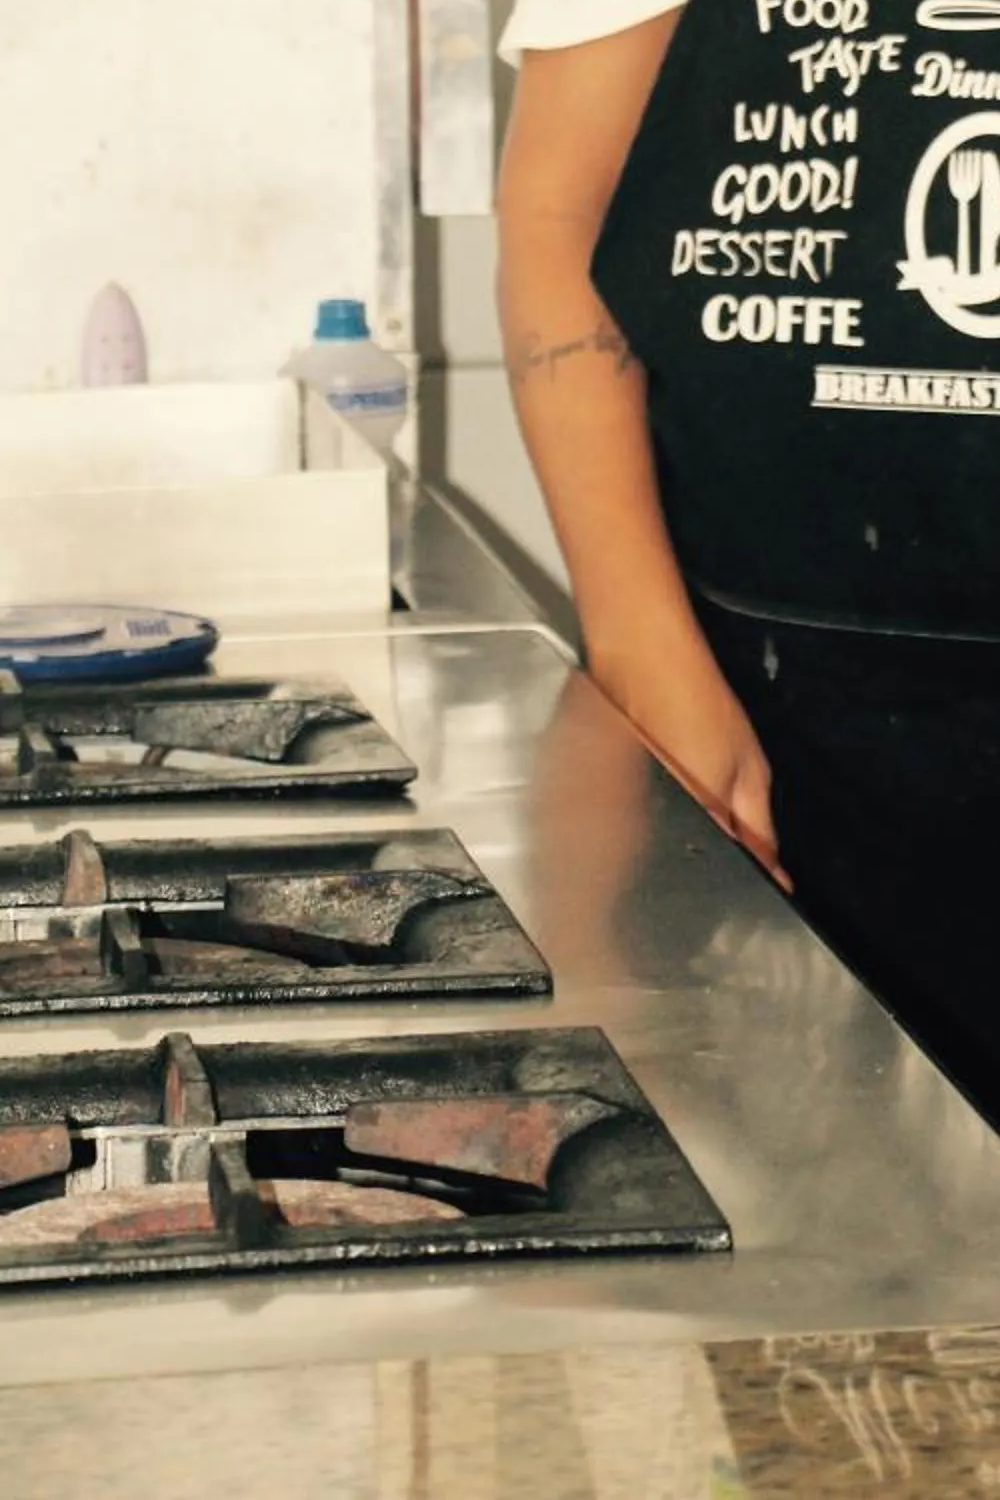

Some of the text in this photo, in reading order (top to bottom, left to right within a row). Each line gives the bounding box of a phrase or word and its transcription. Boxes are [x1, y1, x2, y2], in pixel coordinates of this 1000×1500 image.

[788, 34, 907, 97] TASTE
[734, 102, 859, 153] LUNCH
[711, 156, 860, 225] GOOD!
[671, 228, 848, 283] DESSERT
[701, 293, 865, 347] COFFE
